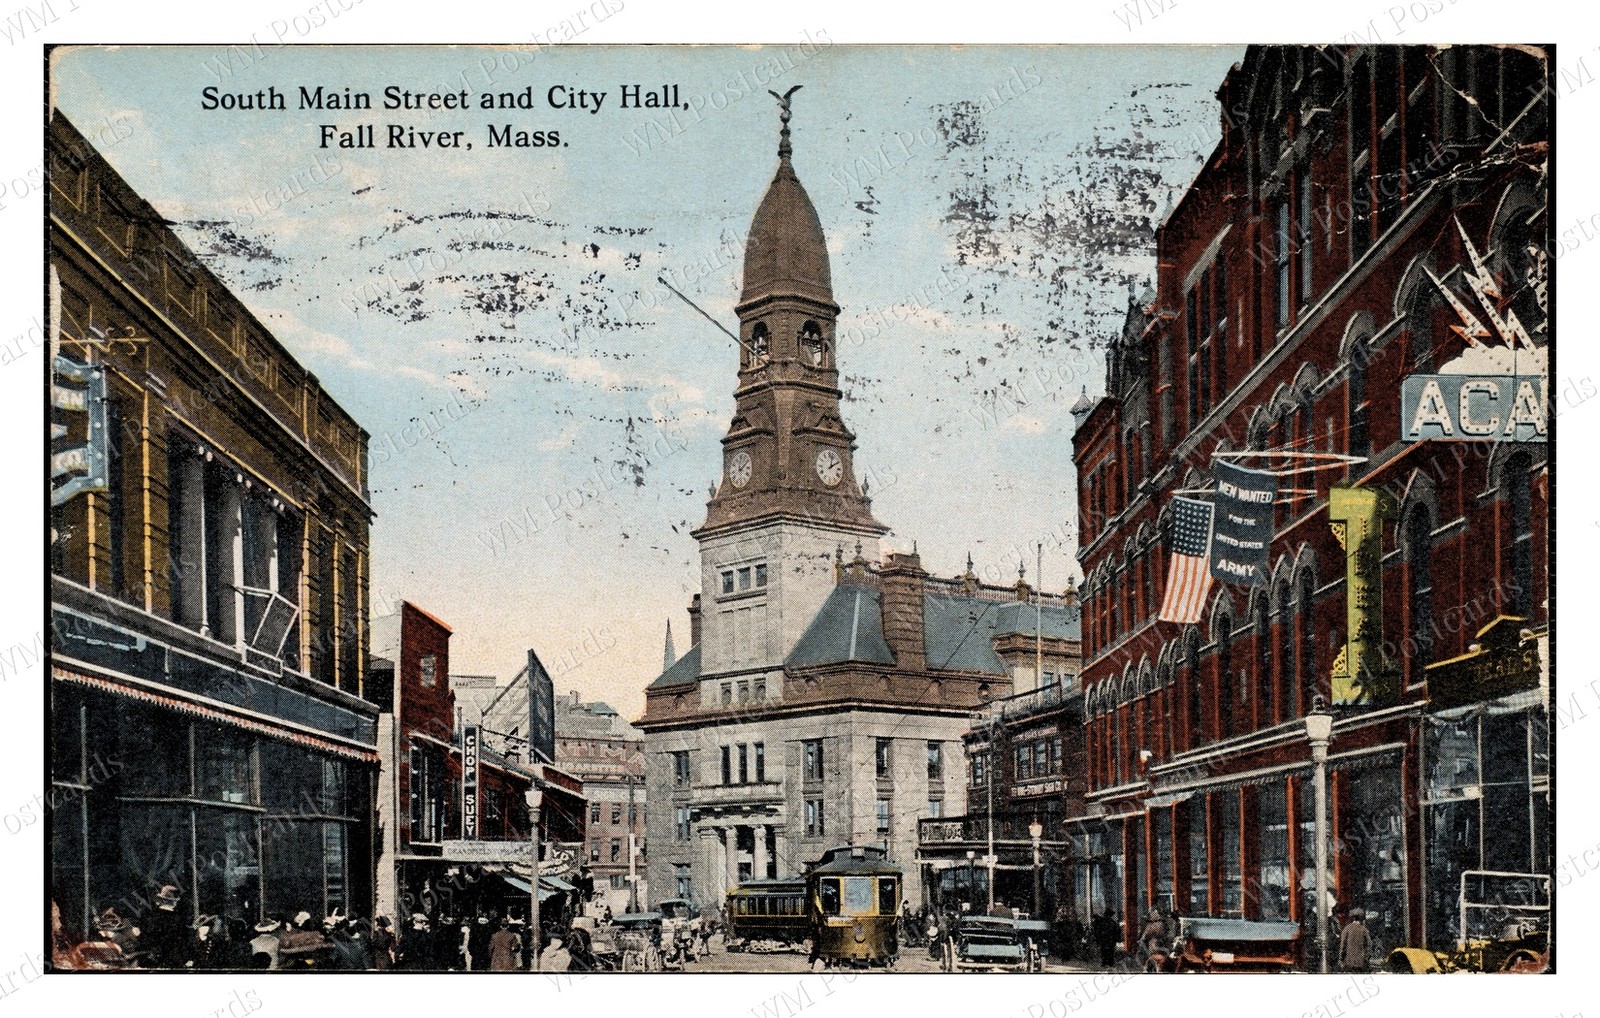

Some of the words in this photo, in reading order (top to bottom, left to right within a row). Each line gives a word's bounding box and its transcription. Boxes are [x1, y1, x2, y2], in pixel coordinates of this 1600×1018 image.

[1409, 379, 1548, 436] ACA
[1218, 480, 1237, 498] MEN
[1238, 487, 1273, 503] WANTED
[1228, 514, 1243, 524] FOR
[1243, 517, 1256, 526] THE
[1215, 532, 1239, 547] UNITED
[1239, 540, 1264, 549] STATES
[1216, 559, 1256, 577] ARMY
[465, 735, 476, 777] CHOP
[465, 793, 477, 836] SUEY
